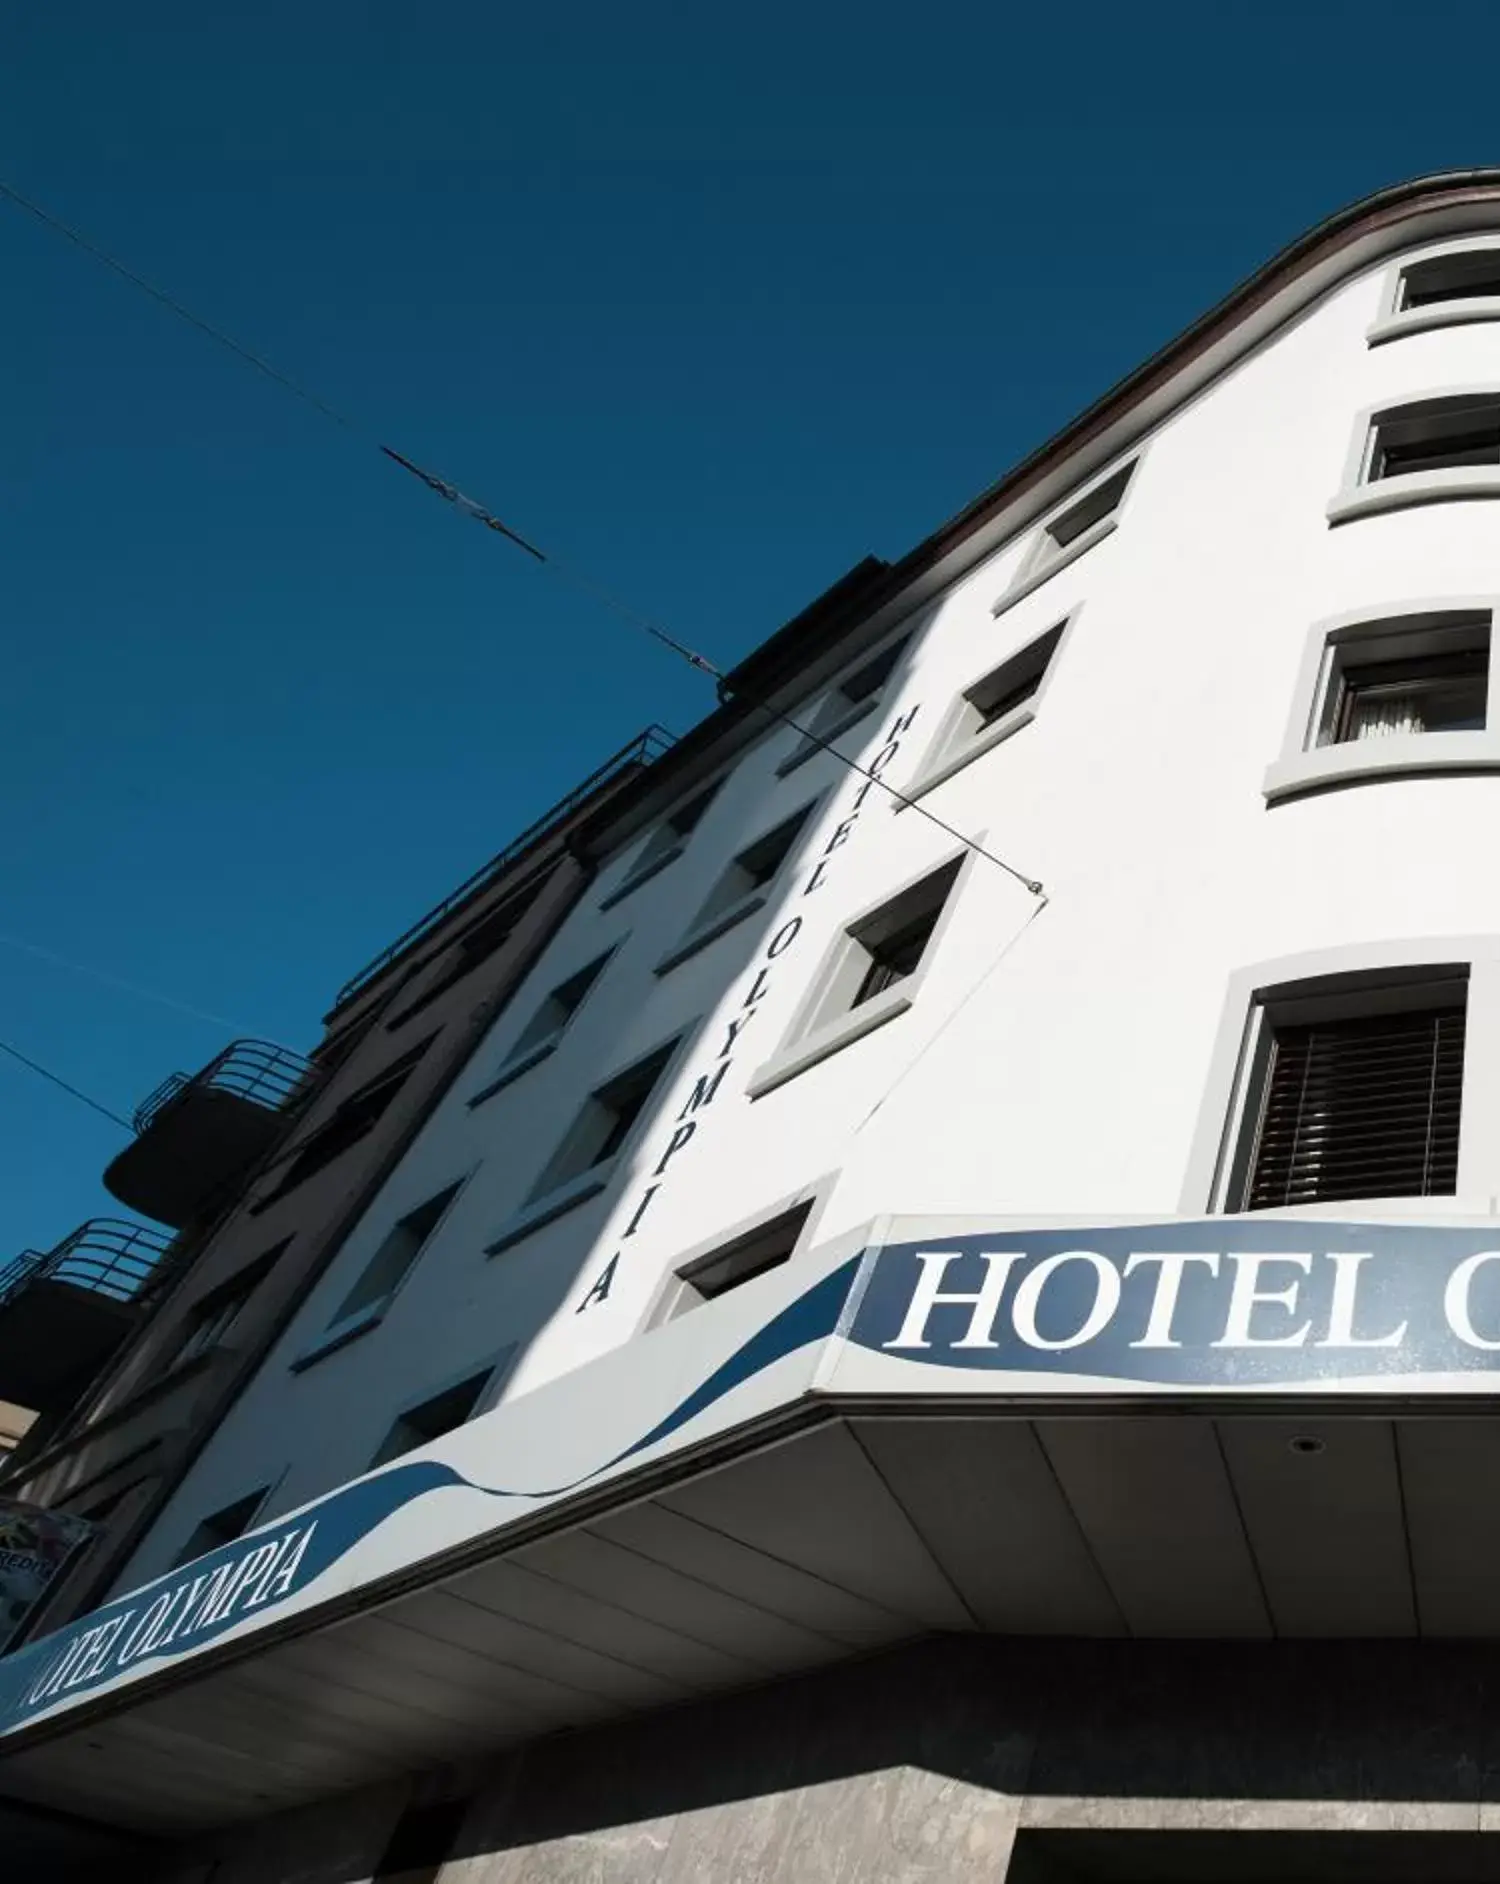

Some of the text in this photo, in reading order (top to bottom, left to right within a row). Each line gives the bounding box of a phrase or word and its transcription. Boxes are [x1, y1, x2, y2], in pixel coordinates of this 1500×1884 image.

[574, 704, 921, 1315] HOTEL OLYMPIA
[883, 1250, 1409, 1350] HOTEL
[117, 1519, 319, 1667] OLYMPIA
